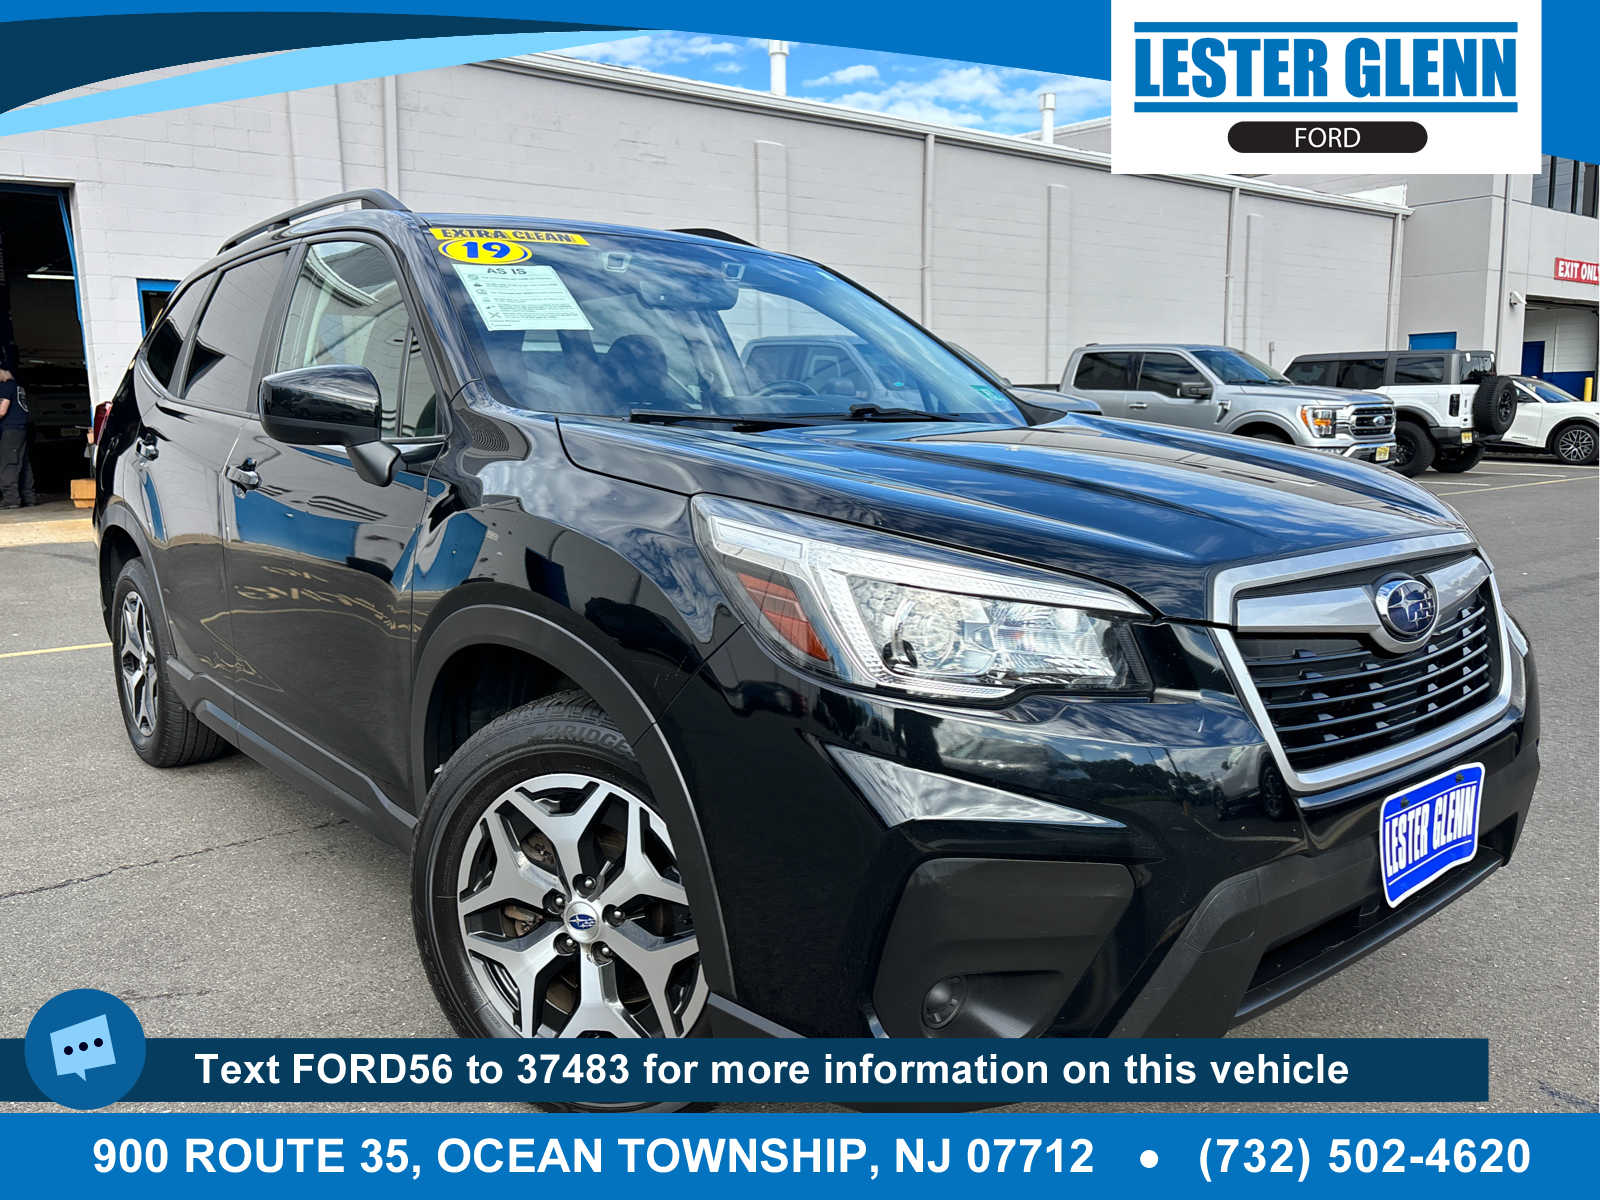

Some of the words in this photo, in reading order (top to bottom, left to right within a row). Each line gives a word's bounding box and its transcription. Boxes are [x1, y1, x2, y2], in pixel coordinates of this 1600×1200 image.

[442, 228, 507, 240] EXTRA
[512, 231, 572, 243] CLEAN
[462, 241, 511, 259] 19
[487, 267, 505, 275] AS
[511, 267, 527, 275] IS
[1558, 260, 1580, 279] EXIT
[1580, 263, 1599, 281] ONL
[1384, 803, 1431, 878] LESTER
[1432, 785, 1477, 850] GLENN
